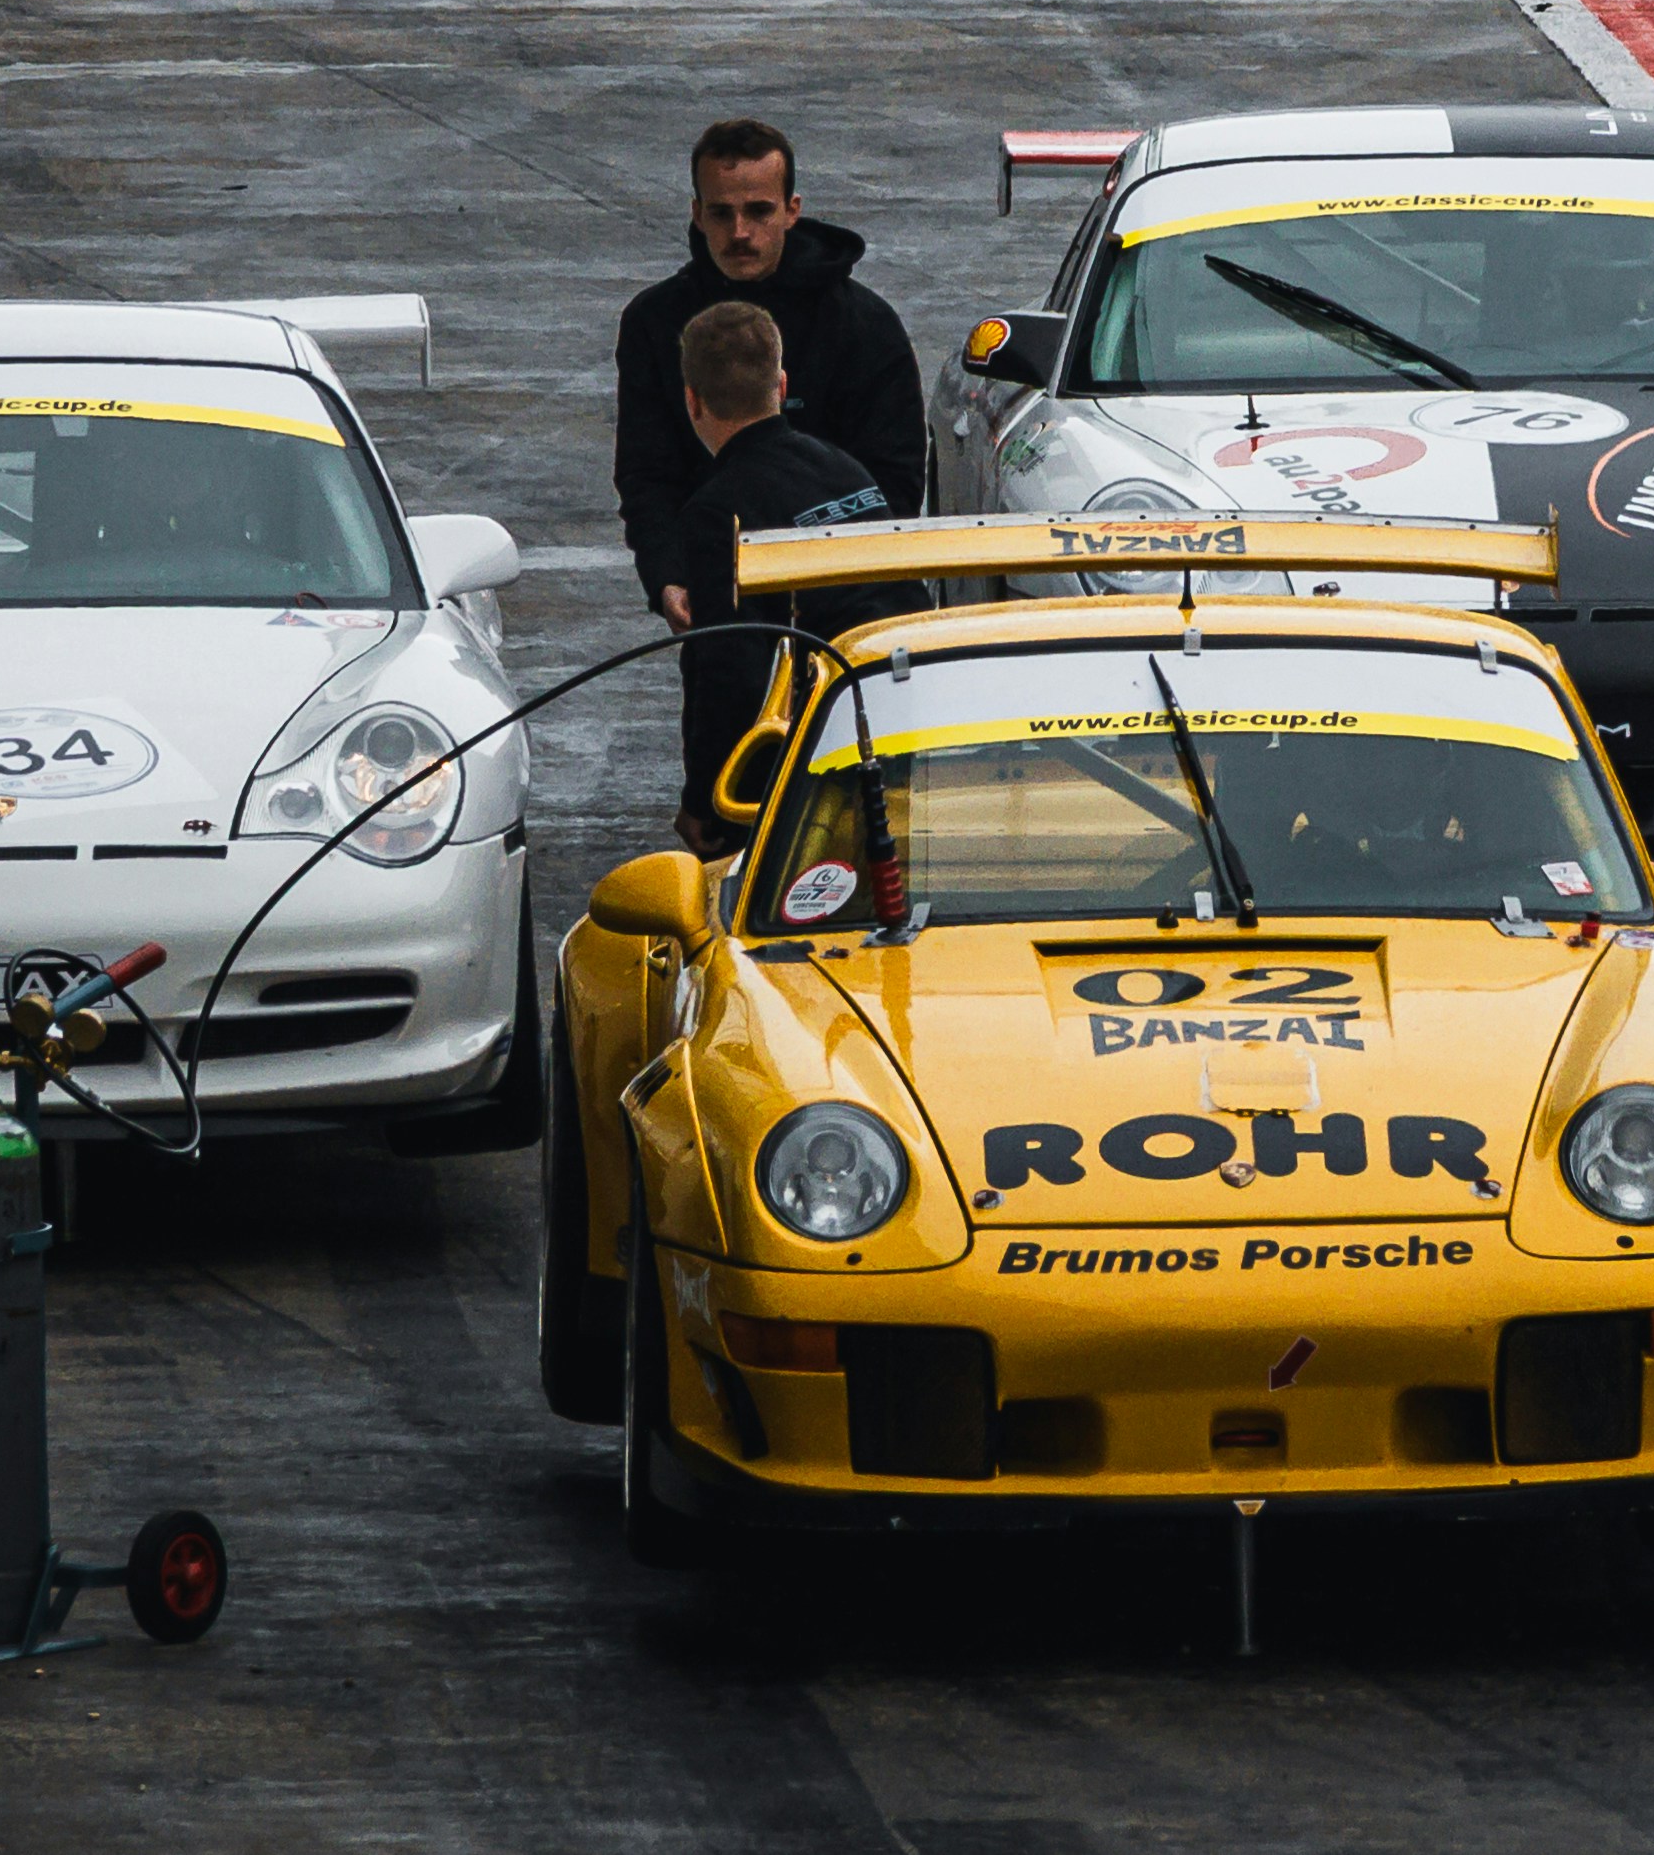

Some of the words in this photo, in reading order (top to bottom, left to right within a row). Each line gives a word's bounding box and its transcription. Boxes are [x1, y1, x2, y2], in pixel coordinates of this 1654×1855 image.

[1317, 195, 1594, 211] www.classic-cup.de
[1453, 405, 1583, 431] 76
[1073, 967, 1362, 1007] 02
[1089, 1010, 1365, 1057] BANZAI
[983, 1113, 1492, 1189] ROHR
[998, 1242, 1220, 1275] Brumos
[1241, 1236, 1475, 1271] Porsche
